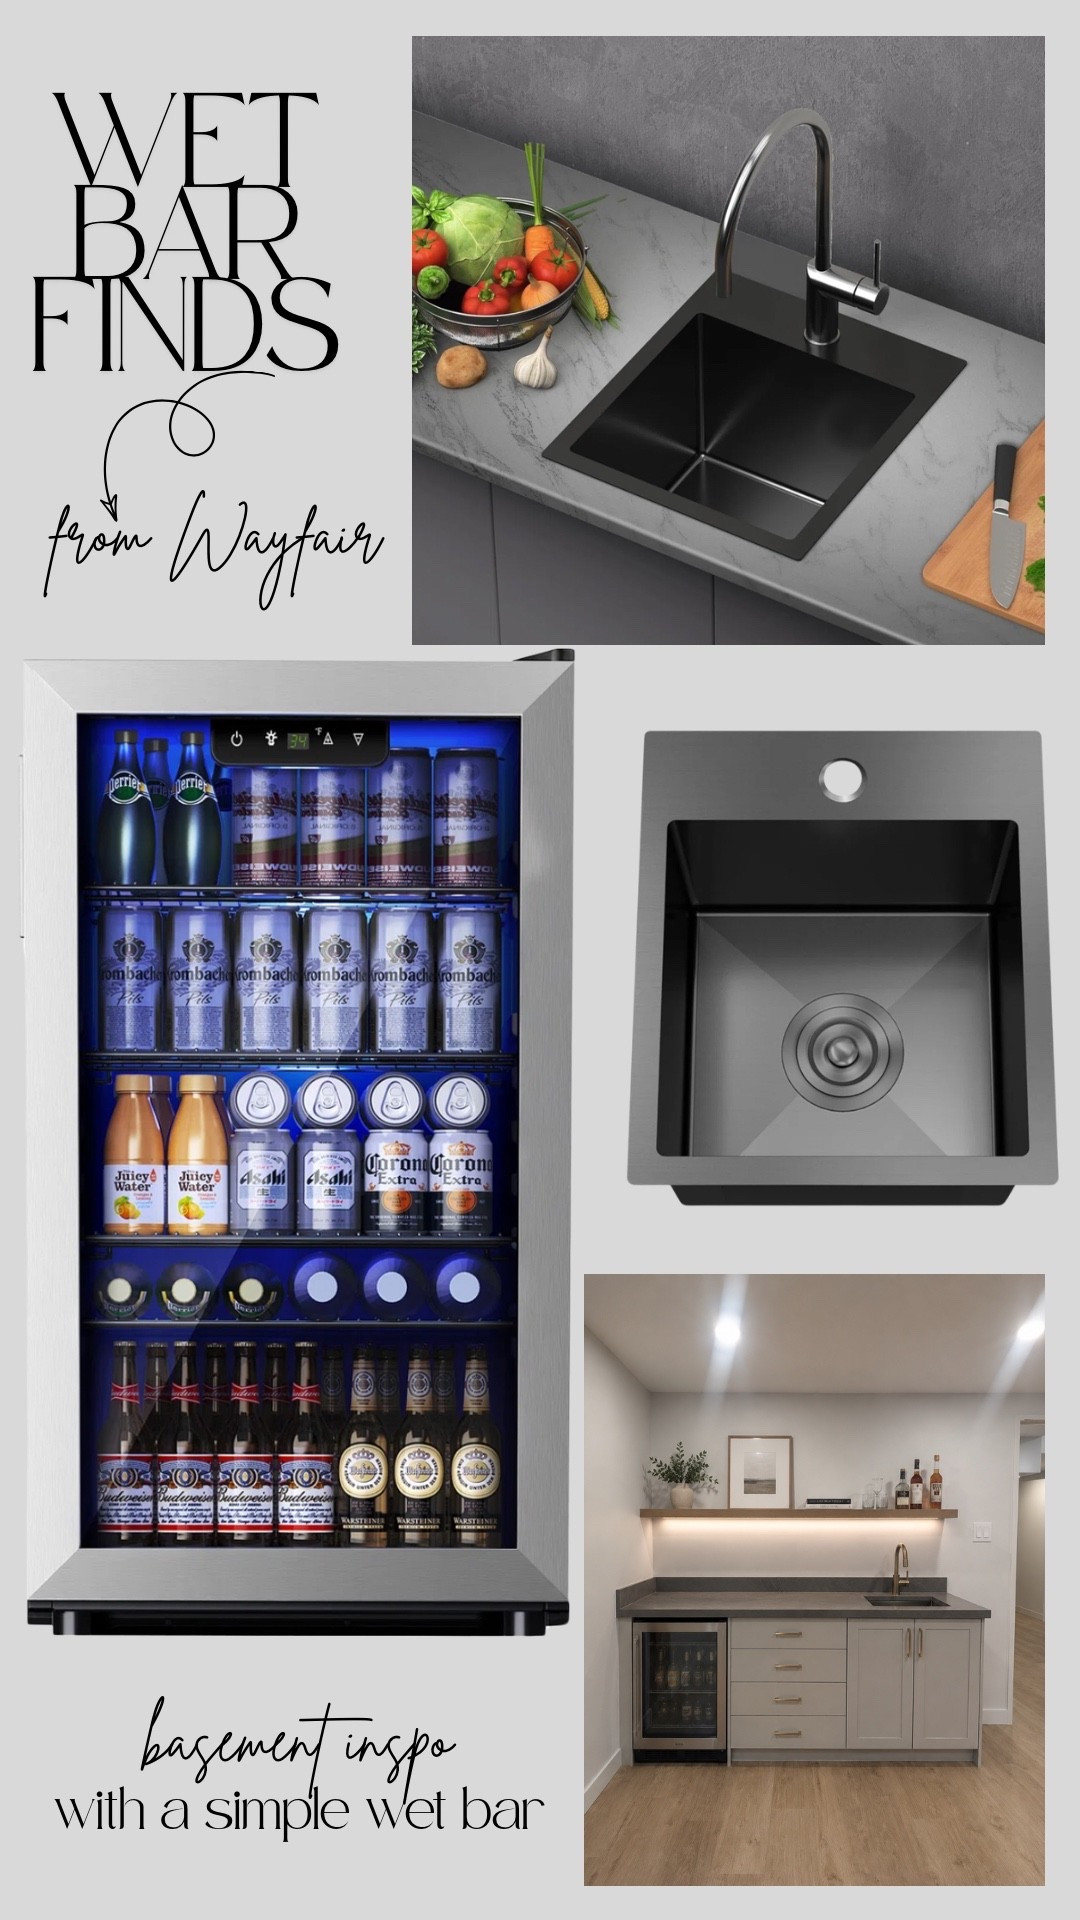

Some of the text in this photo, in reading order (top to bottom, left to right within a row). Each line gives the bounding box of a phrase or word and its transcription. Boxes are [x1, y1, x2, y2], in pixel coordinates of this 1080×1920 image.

[289, 734, 308, 749] 34
[114, 990, 144, 1006] Pils
[183, 990, 213, 1006] Pils
[251, 990, 281, 1006] Pils
[320, 991, 350, 1007] Pils
[387, 991, 417, 1007] Pils
[455, 992, 484, 1007] Pils
[114, 1169, 150, 1184] Juicy
[178, 1169, 214, 1184] Juicy
[239, 1168, 286, 1186] Asahi
[306, 1168, 353, 1186] Asahi
[377, 1172, 417, 1185] Extra
[442, 1172, 482, 1185] Extra
[113, 1181, 151, 1192] Water
[178, 1181, 216, 1192] Water
[453, 1517, 497, 1525] WARSTEINER
